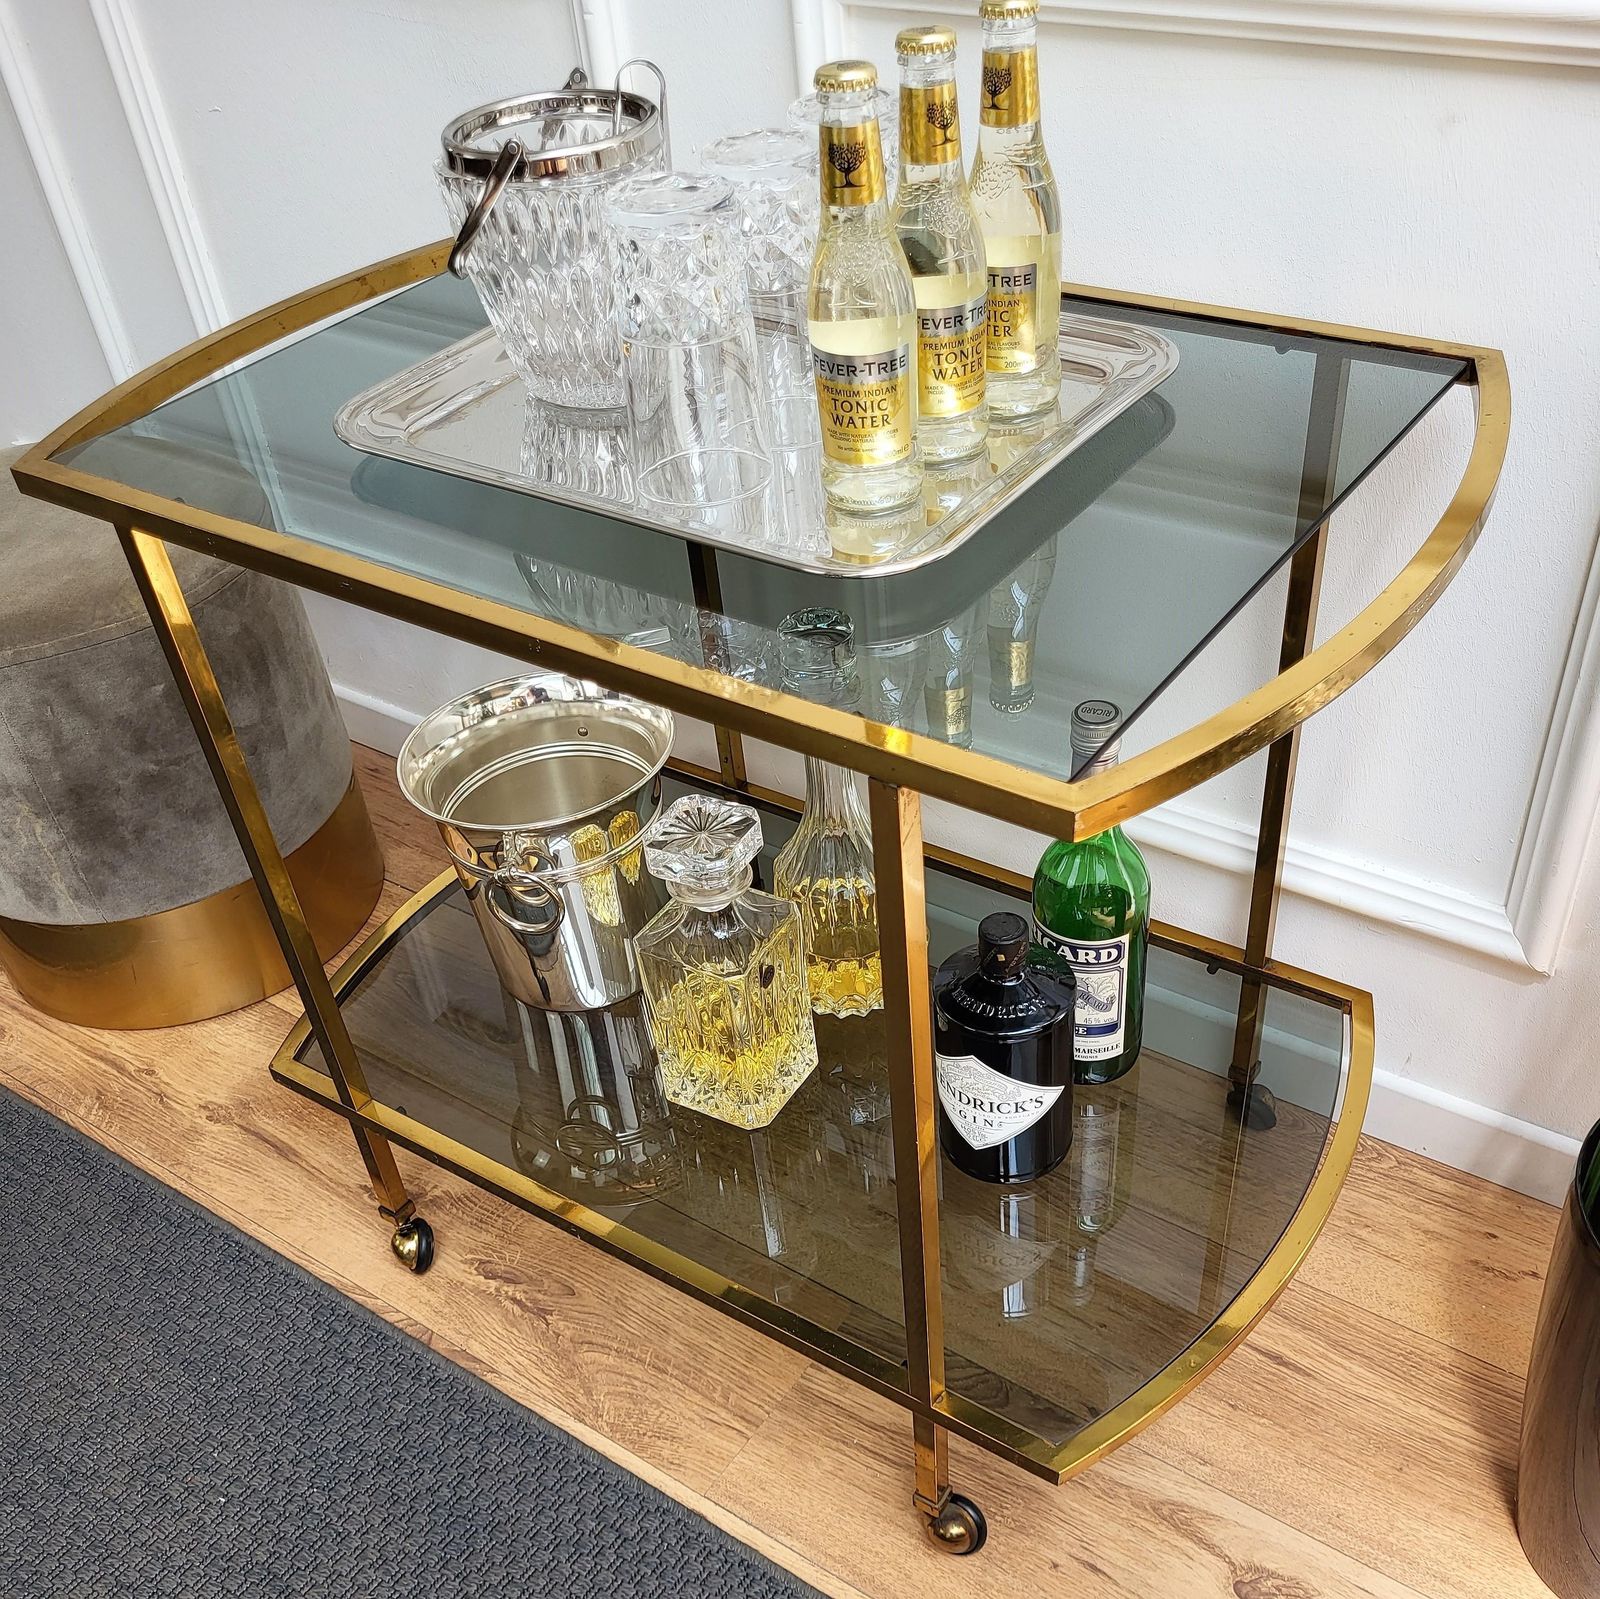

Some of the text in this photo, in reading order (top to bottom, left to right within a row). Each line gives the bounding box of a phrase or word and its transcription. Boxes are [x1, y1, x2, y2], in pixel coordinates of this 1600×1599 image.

[987, 272, 1032, 288] -TREE
[988, 299, 1020, 308] INDIAN
[986, 309, 1010, 323] NIC
[986, 324, 1013, 337] TER
[923, 339, 965, 351] PREMIUM
[934, 341, 982, 366] TONIC
[813, 353, 906, 378] FEVER-TREE
[931, 356, 983, 381] WATER
[822, 384, 898, 398] PREMIUM INDIAN
[831, 398, 889, 414] TONIC
[830, 413, 893, 430] WATER
[1081, 706, 1113, 718] RICARD
[1079, 992, 1109, 1011] RICARD
[1075, 1042, 1121, 1055] MARSEILLE
[937, 1071, 1044, 1115] ENDRICK'S
[958, 1109, 994, 1128] GIN
